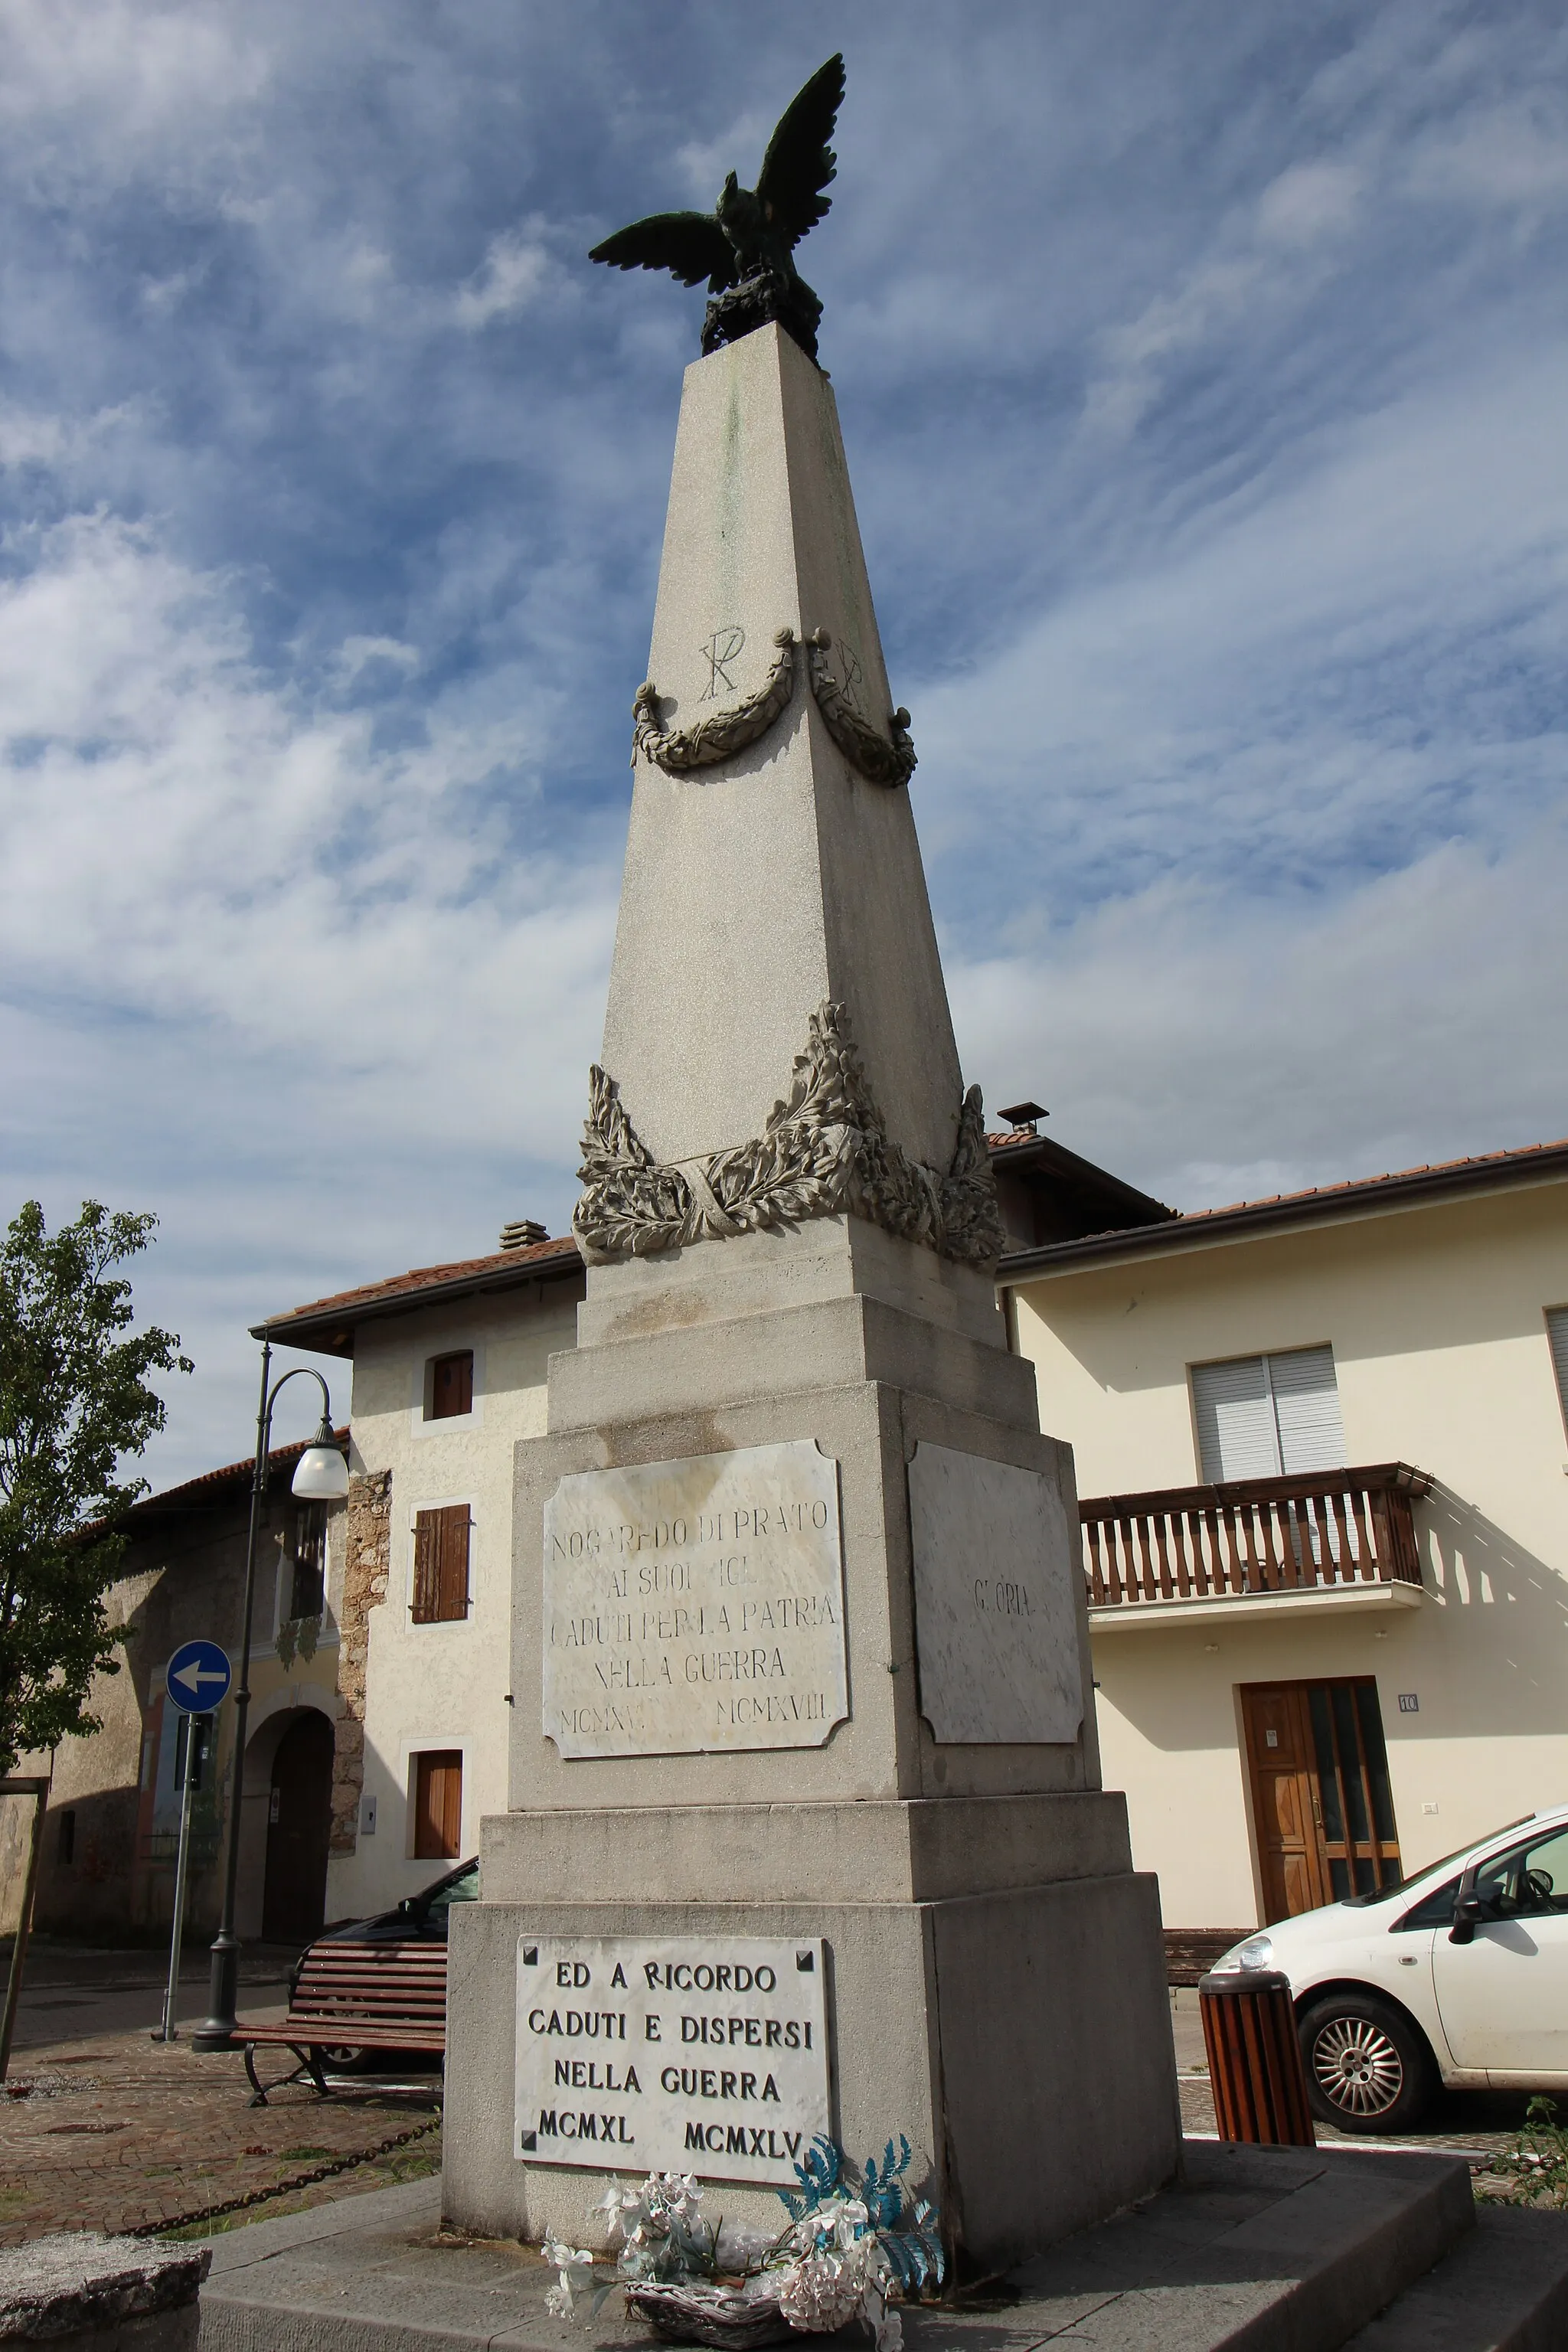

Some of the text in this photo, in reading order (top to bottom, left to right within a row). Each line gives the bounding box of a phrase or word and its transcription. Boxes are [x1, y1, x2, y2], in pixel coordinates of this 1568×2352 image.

[552, 1501, 827, 1560] NOGAREDO DI PRATO
[607, 1554, 764, 1598] AI SUOI IGL
[974, 1579, 1031, 1615] GORIA
[551, 1592, 836, 1646] CADUTI PER LA PATRIA
[595, 1648, 786, 1690] NELLA GUERRA
[1401, 1696, 1416, 1710] 10
[556, 1961, 777, 1992] ED A RICORDO
[528, 2009, 812, 2049] CADUTI E DISPERSI
[554, 2060, 781, 2102] NELLA GUERRA
[538, 2109, 802, 2160] MCMXL MCMXLV
